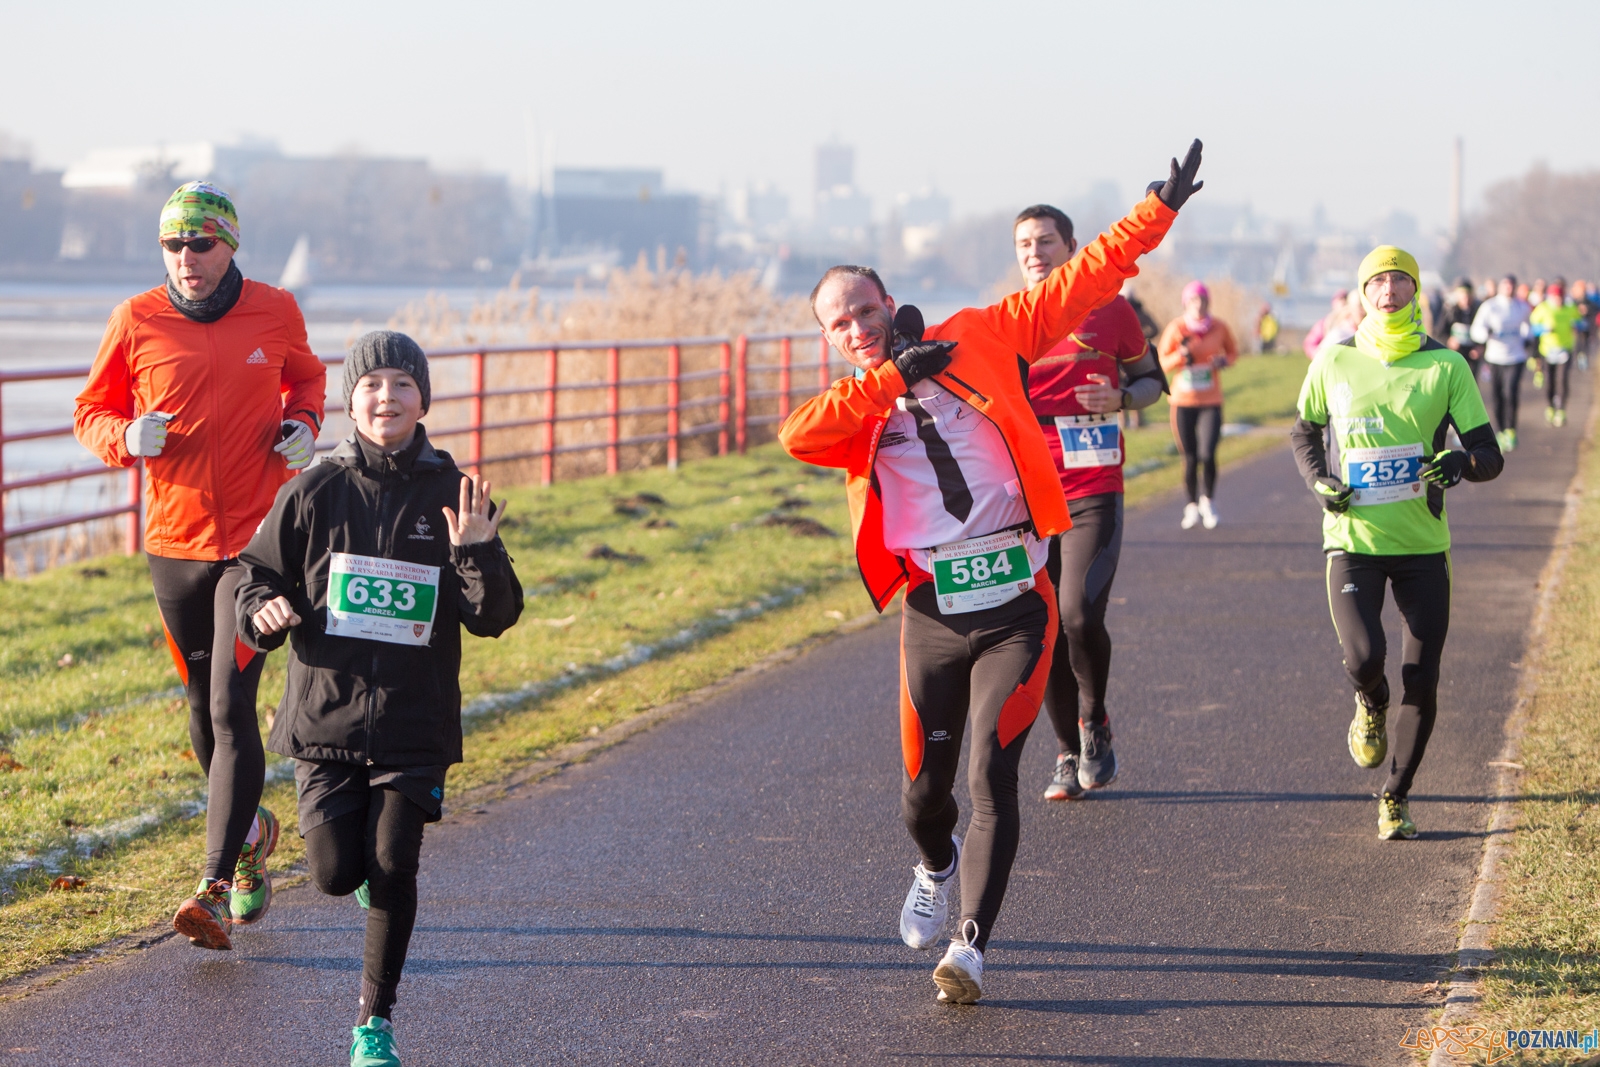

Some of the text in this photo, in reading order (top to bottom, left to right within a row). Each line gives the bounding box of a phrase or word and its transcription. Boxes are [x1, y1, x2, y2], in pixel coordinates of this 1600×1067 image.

[1078, 427, 1104, 445] 41
[1360, 459, 1410, 484] 252
[957, 543, 972, 551] BIEG
[971, 533, 1016, 547] SYLWESTROWY
[953, 547, 985, 558] RYSZARDA
[345, 565, 356, 573] IM.
[357, 567, 394, 577] RYSZARDA
[364, 559, 381, 568] BIEG
[382, 561, 431, 575] SYLWESTROWY
[951, 550, 1013, 585] 584
[970, 580, 997, 589] MARCIN
[347, 576, 416, 611] 633
[362, 607, 396, 616] JEDRZEJ
